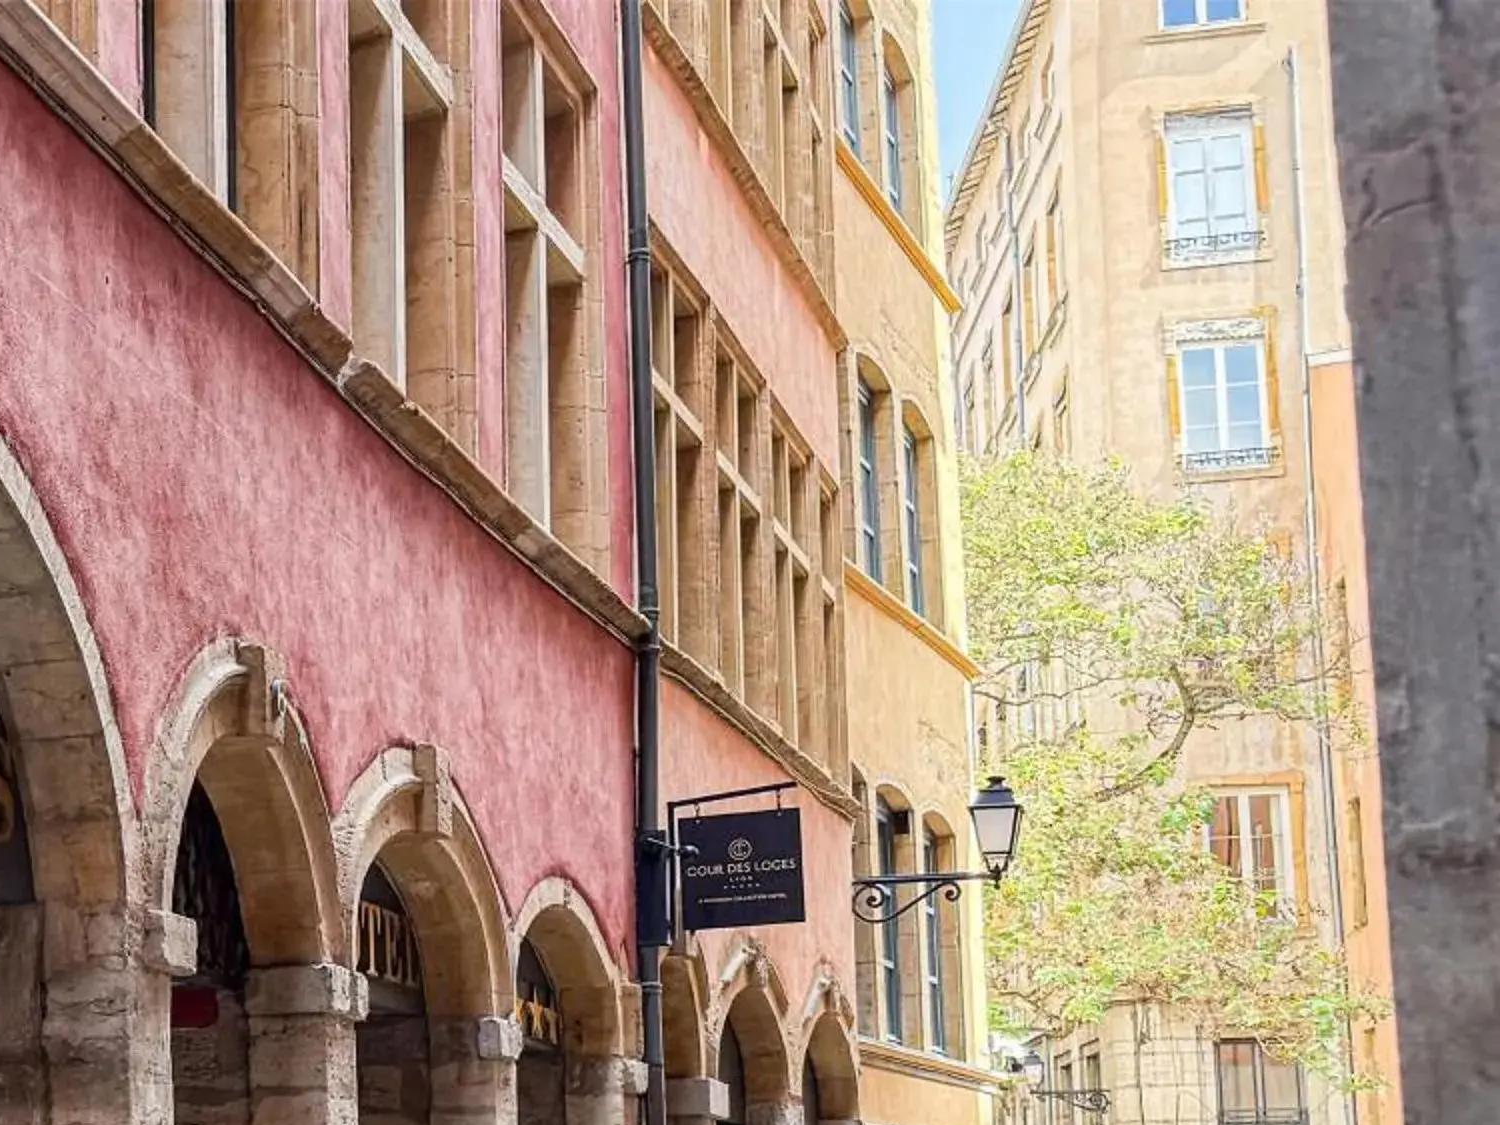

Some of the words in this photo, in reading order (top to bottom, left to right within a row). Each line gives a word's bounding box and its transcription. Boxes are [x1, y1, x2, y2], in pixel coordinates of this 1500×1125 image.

[687, 865, 725, 878] COUR
[727, 862, 751, 875] DES
[754, 858, 797, 872] LOGES
